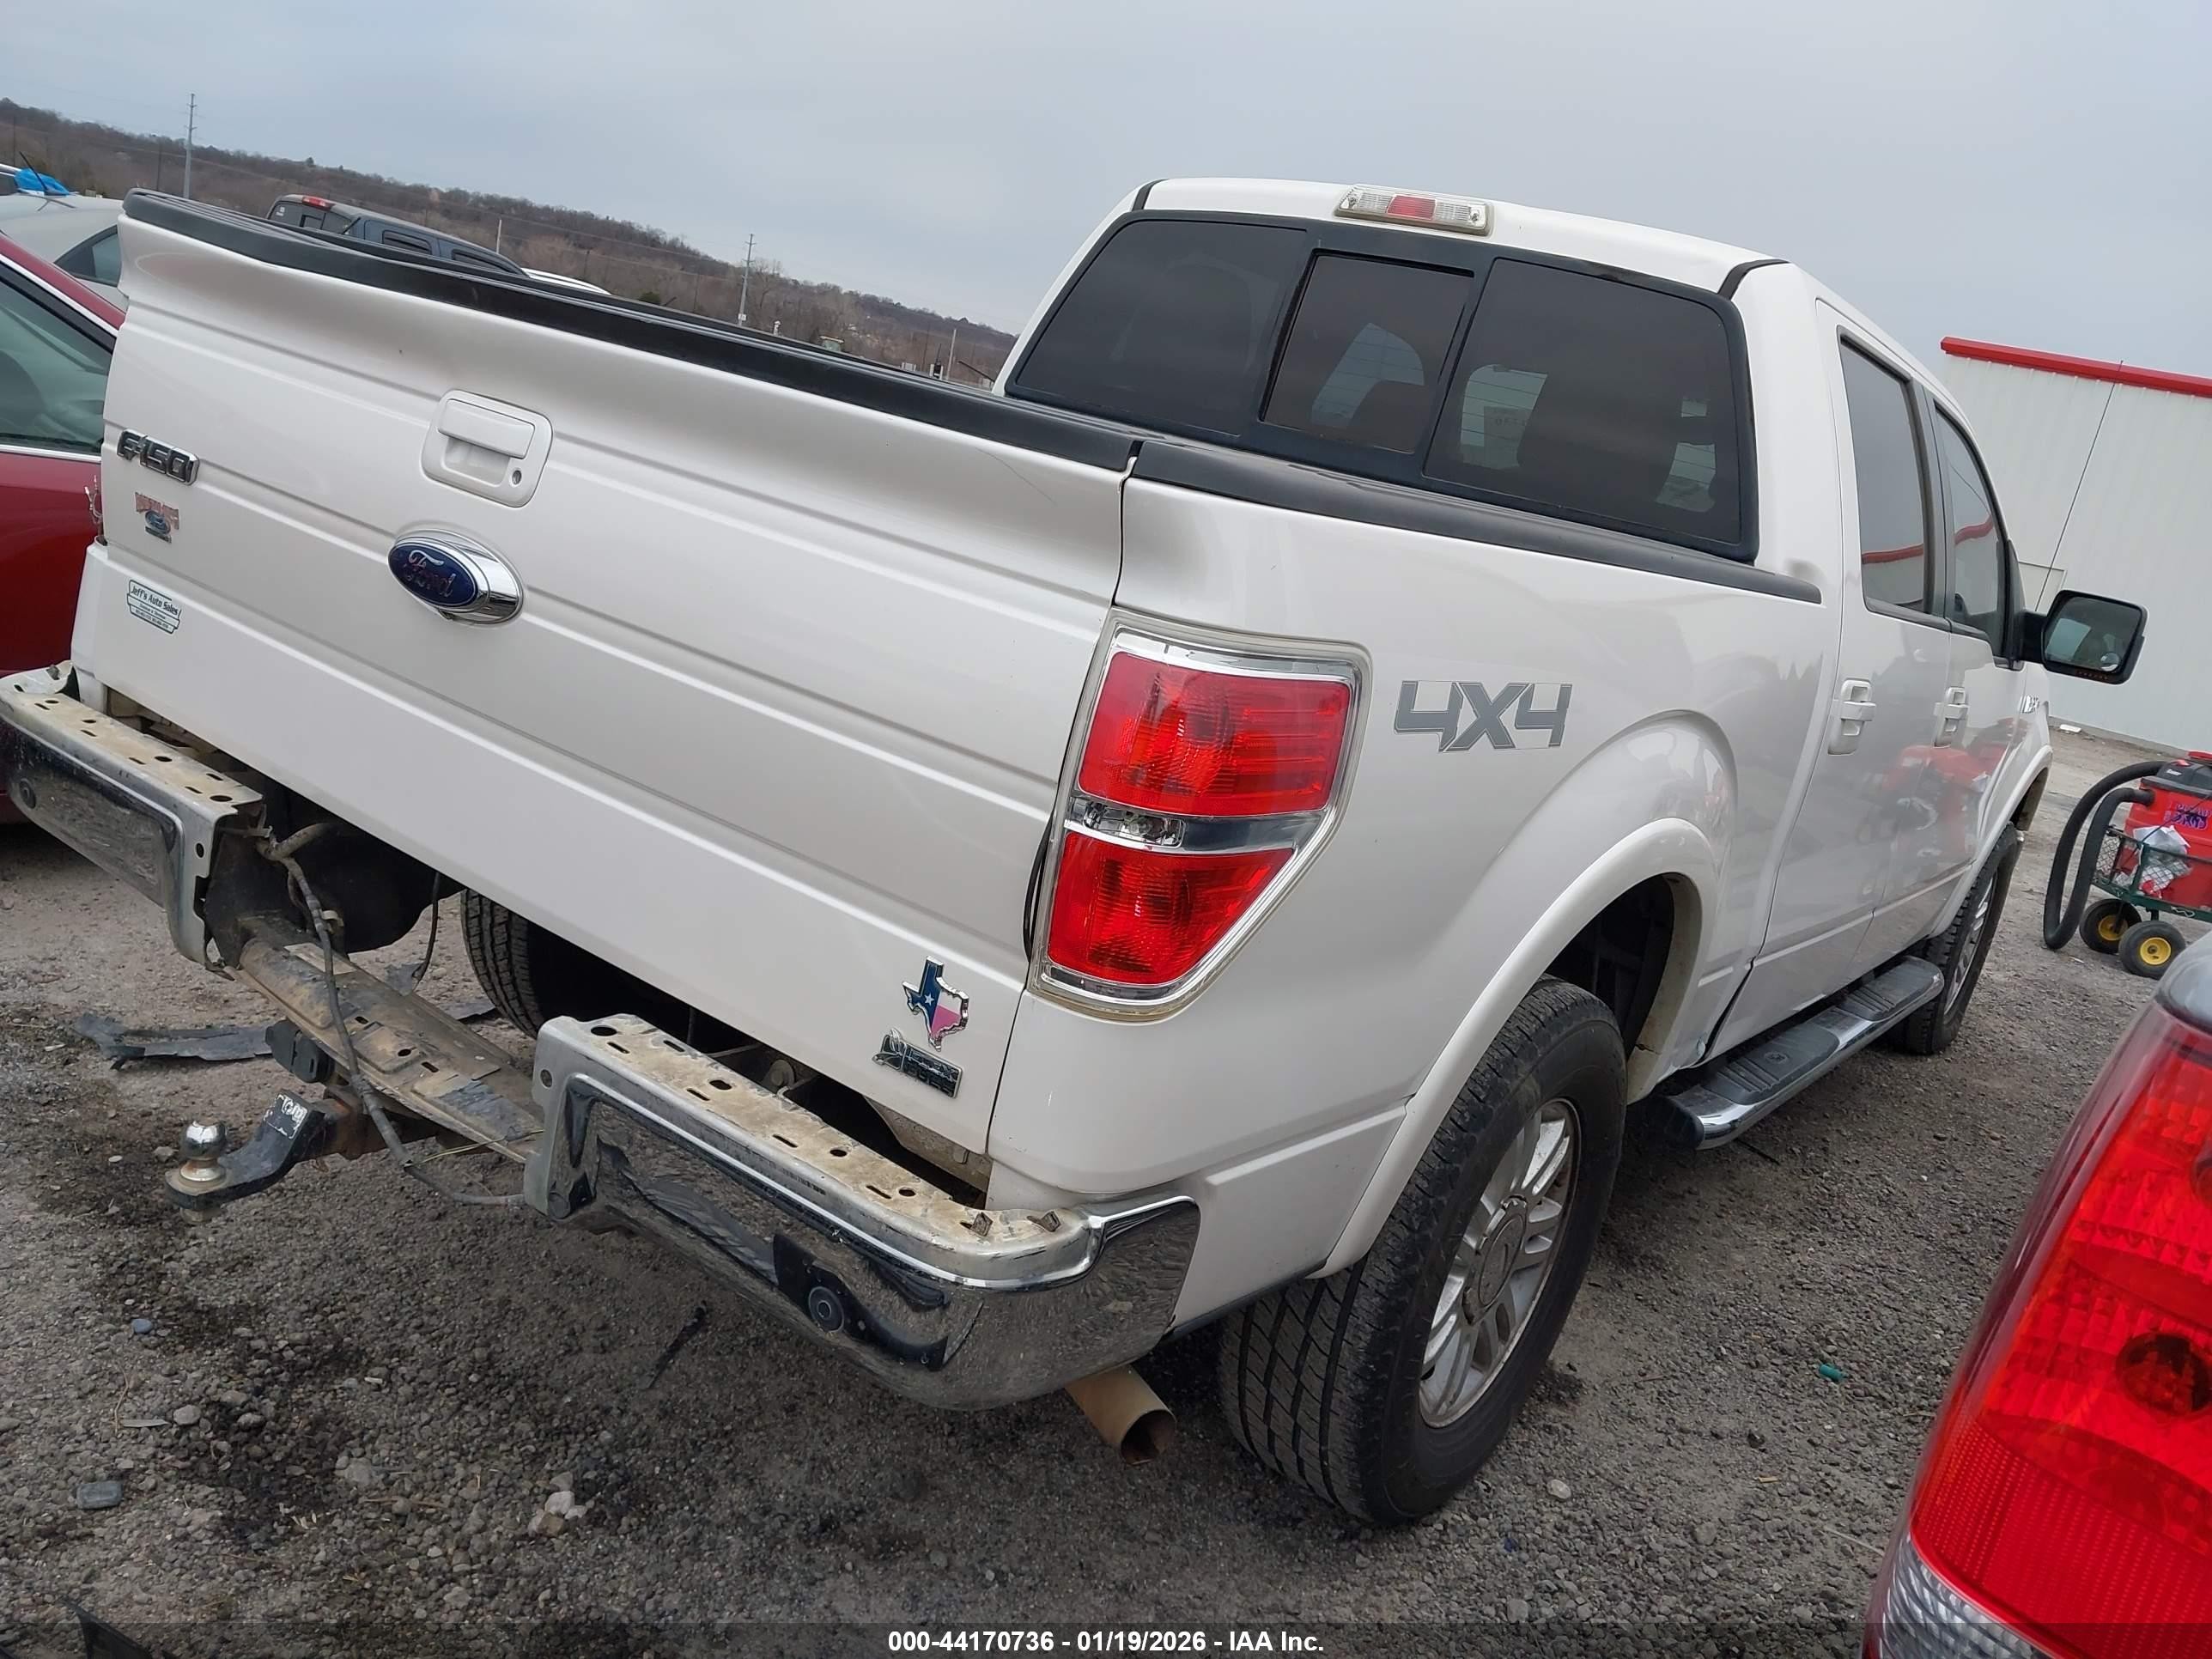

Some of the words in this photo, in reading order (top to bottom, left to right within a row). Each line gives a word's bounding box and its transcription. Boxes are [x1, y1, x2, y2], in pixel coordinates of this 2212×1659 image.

[131, 586, 149, 600] Jeff's
[148, 594, 163, 608] Auto
[162, 601, 179, 616] Sales
